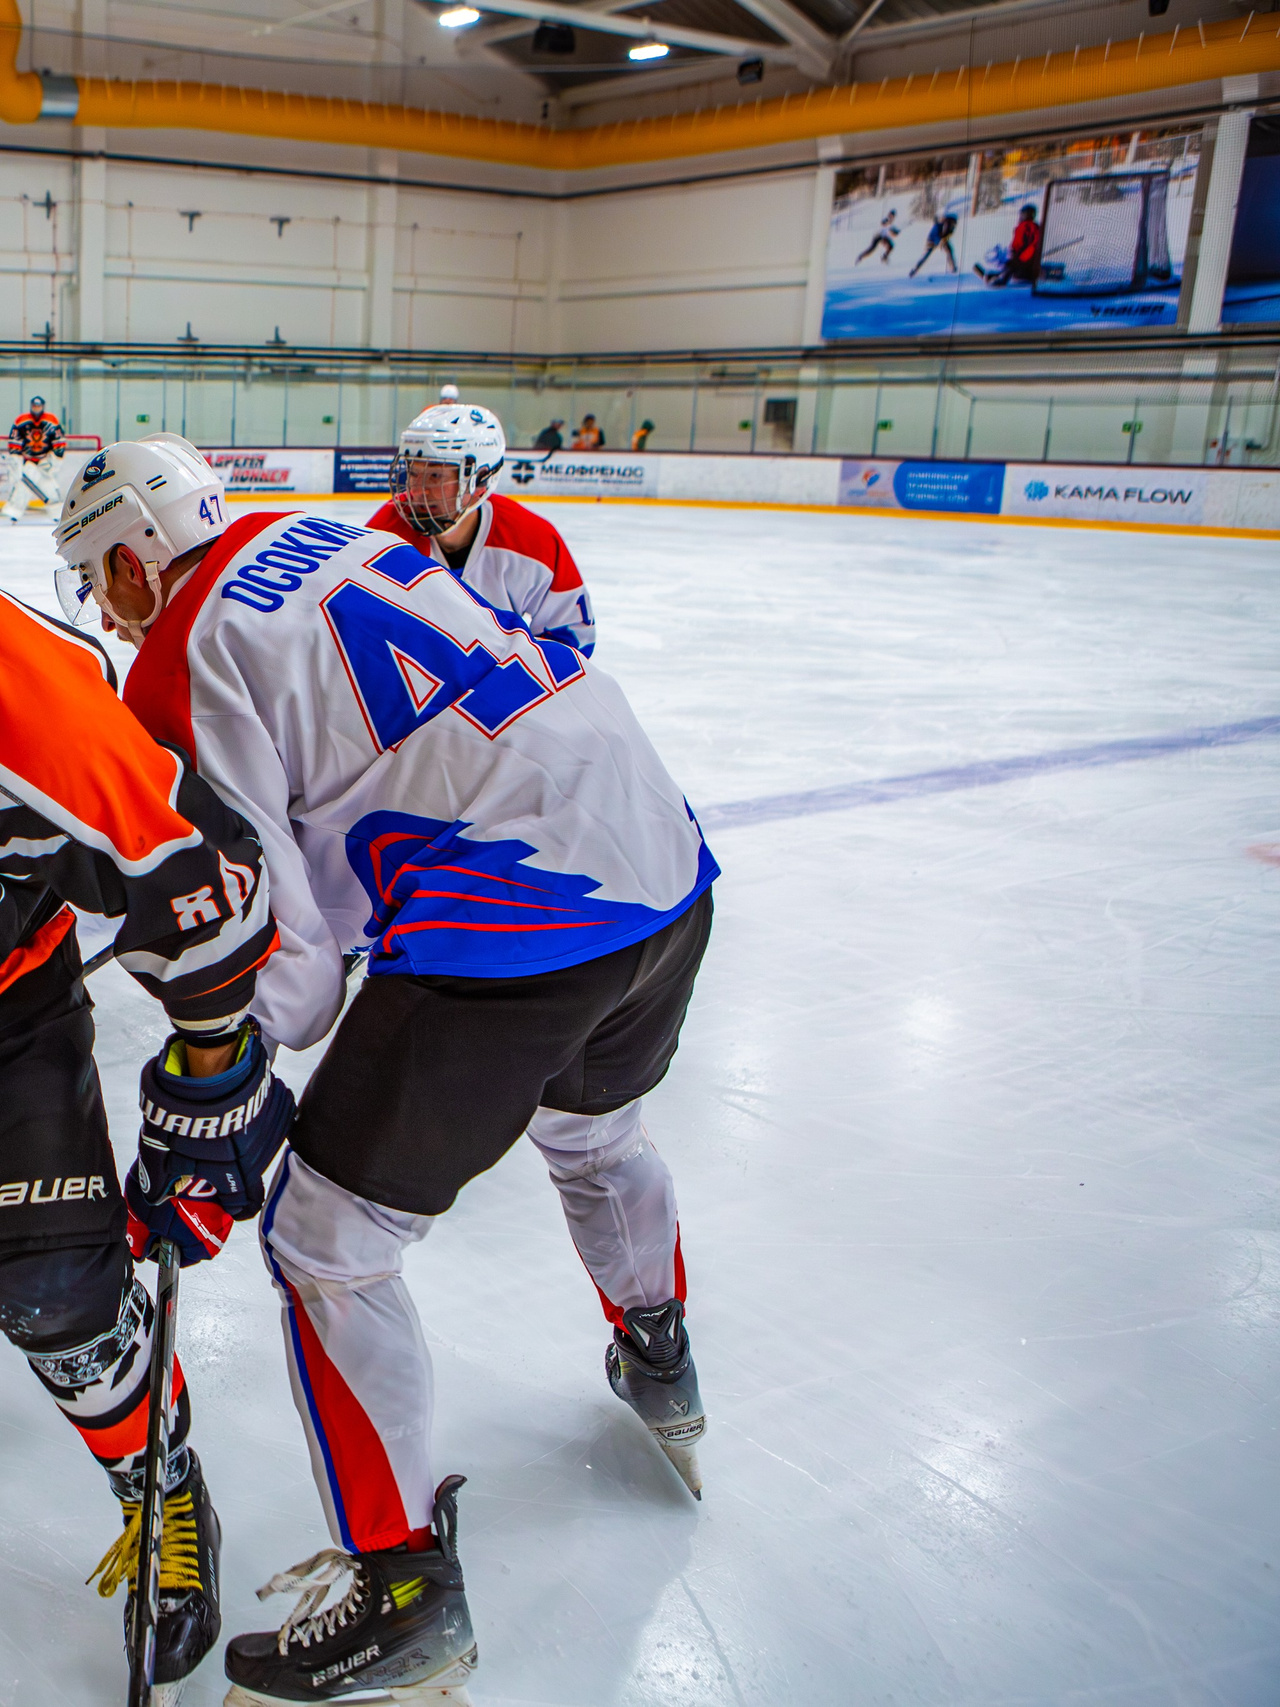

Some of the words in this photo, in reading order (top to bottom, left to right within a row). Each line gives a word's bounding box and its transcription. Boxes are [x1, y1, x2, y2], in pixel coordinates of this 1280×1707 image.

[198, 493, 224, 527] 47
[1054, 484, 1119, 501] KAMA
[1123, 486, 1193, 504] FLOW
[80, 494, 124, 530] BAUER
[575, 594, 596, 626] 1
[319, 541, 587, 757] 47
[666, 1423, 703, 1438] BAUER
